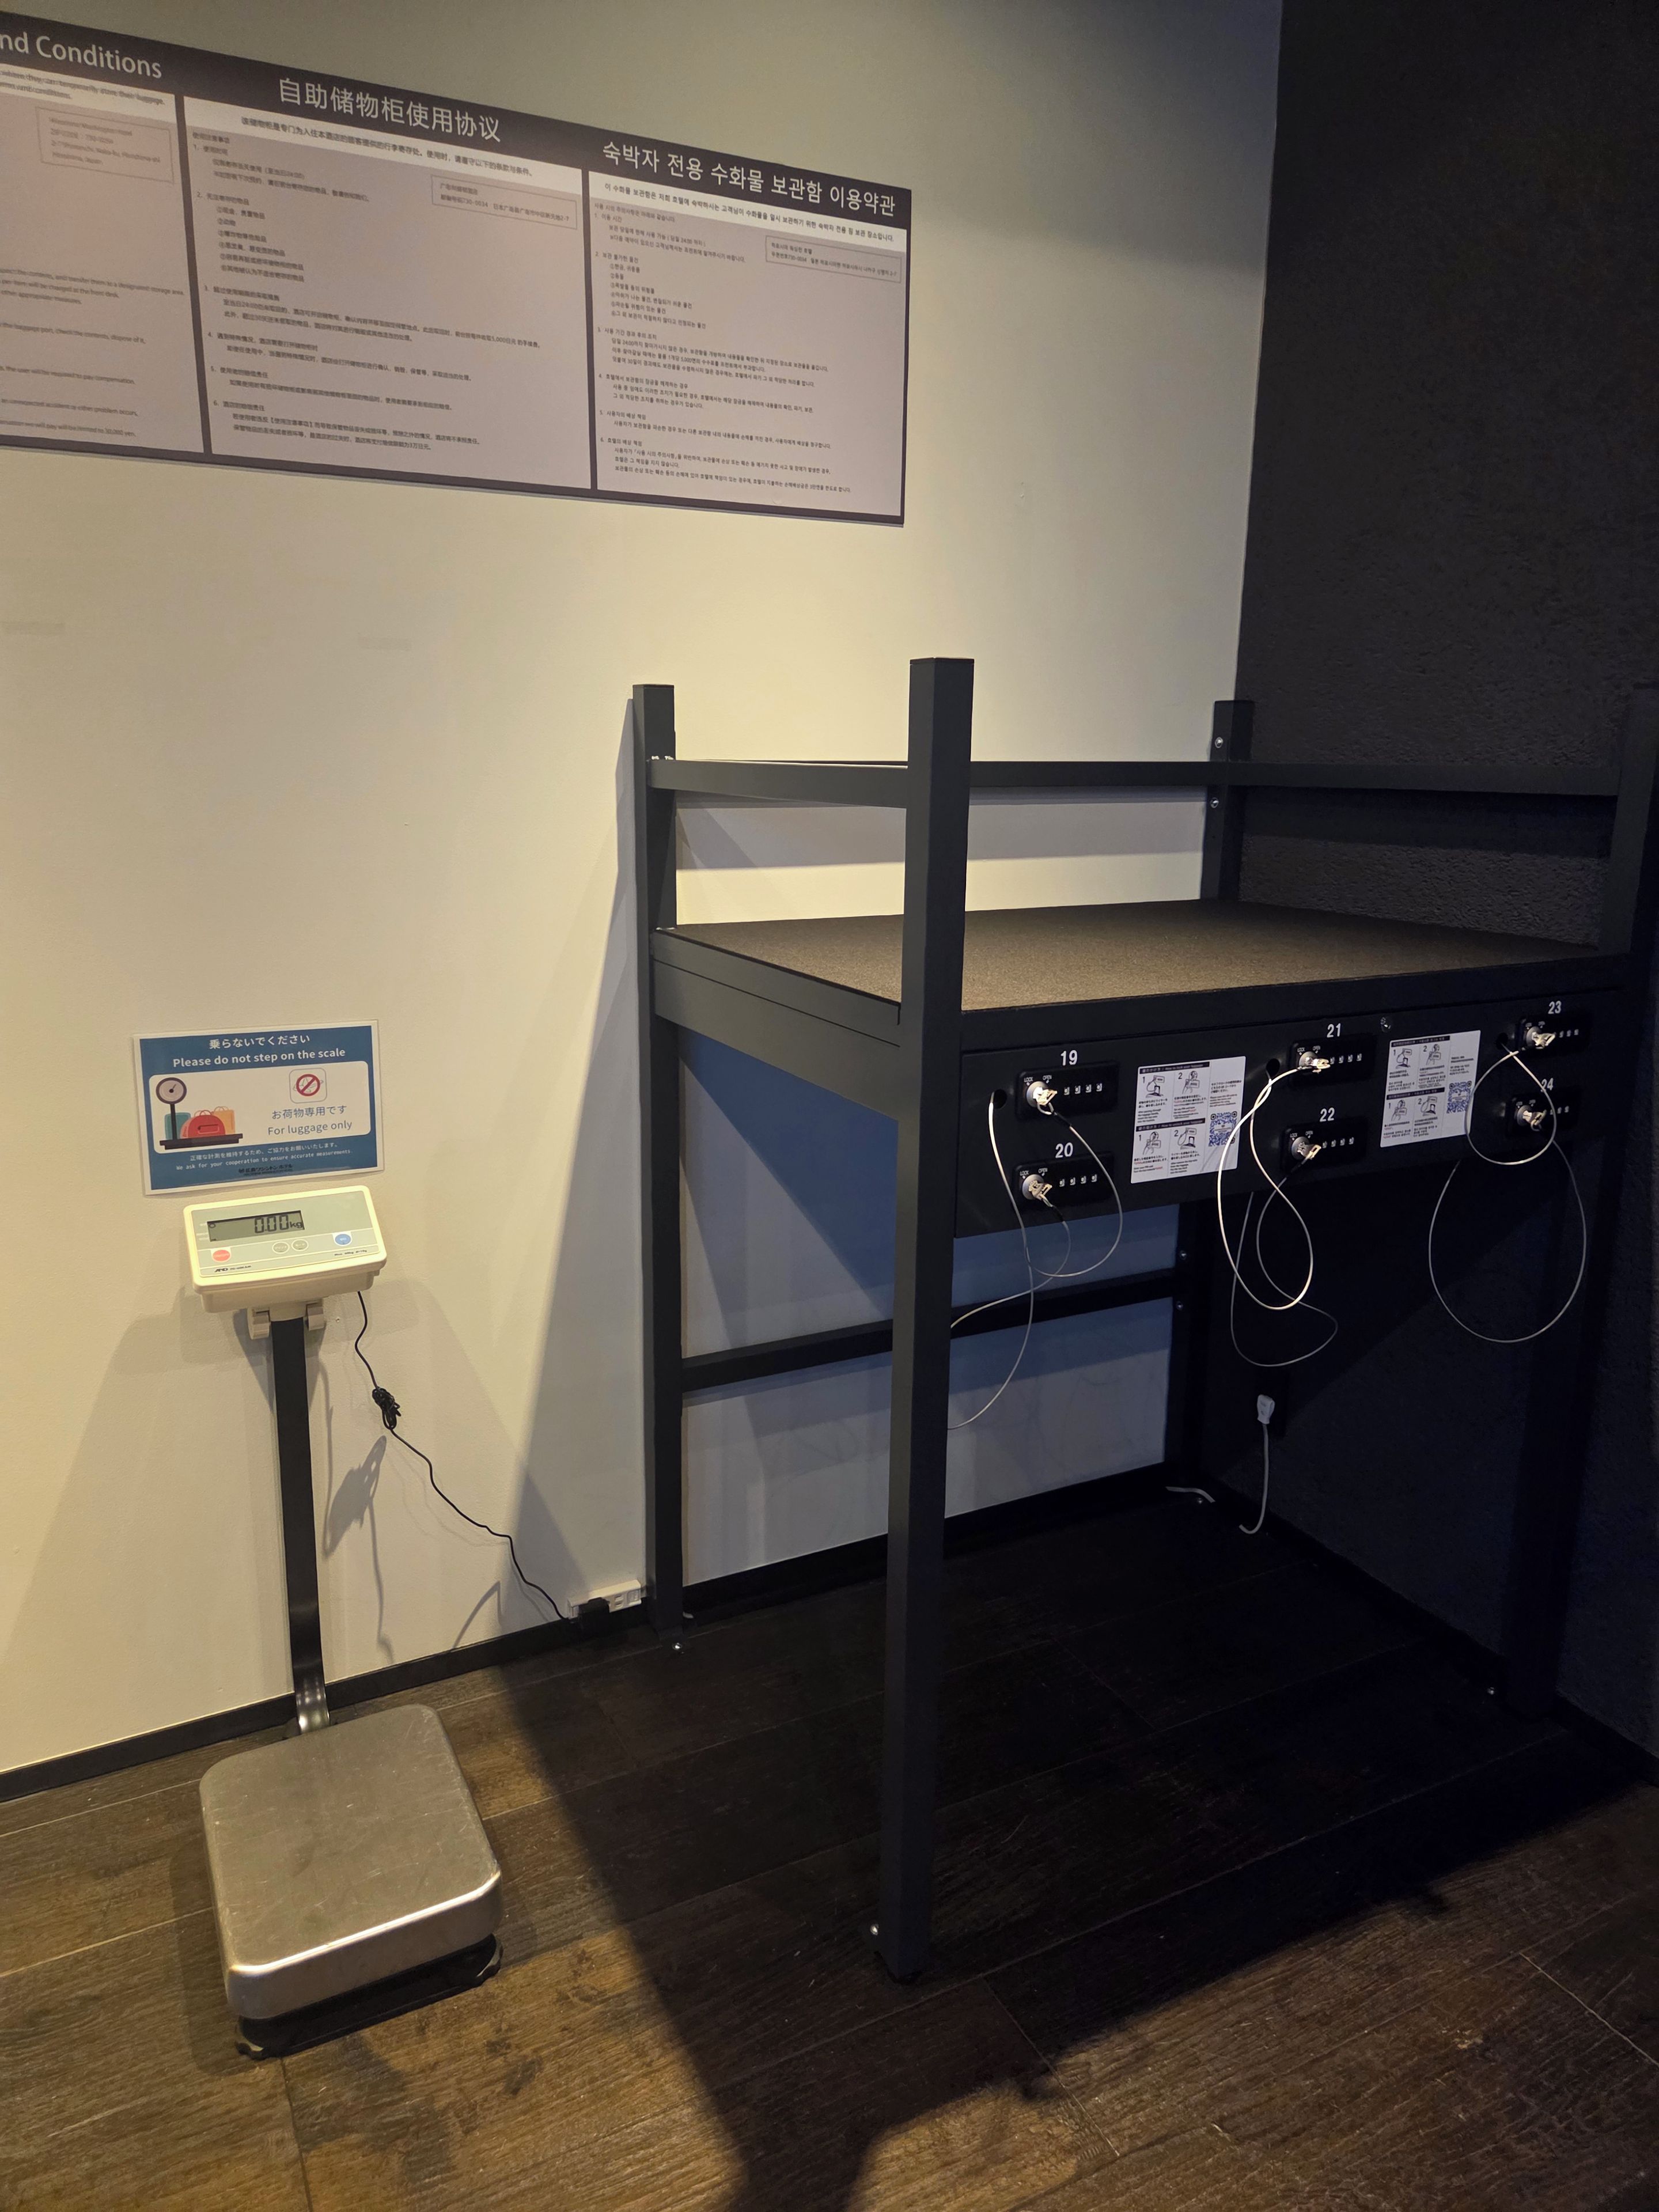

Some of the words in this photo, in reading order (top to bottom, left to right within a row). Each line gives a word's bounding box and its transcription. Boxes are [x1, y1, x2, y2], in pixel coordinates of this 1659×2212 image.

[0, 26, 29, 54] nd
[35, 33, 161, 79] Conditions
[279, 75, 500, 143] 自助储物柜使用协议
[602, 139, 660, 173] 숙박자
[667, 151, 703, 182] 전용
[710, 160, 764, 194] 수화물
[770, 172, 823, 204] 보관함
[829, 183, 896, 218] 이용약관
[604, 182, 611, 191] 이
[612, 184, 631, 195] 수화물
[632, 187, 656, 200] 보관함은
[672, 195, 690, 206] 호텔에
[691, 198, 719, 212] 숙박하시는
[721, 204, 744, 216] 고객님이
[782, 215, 804, 227] 보관하기
[854, 228, 865, 237] 보관
[1548, 1001, 1562, 1014] 23
[1327, 1023, 1341, 1037] 21
[208, 1033, 310, 1050] 乗らないでください
[172, 1055, 211, 1067] Please
[213, 1054, 229, 1065] do
[231, 1054, 251, 1063] not
[253, 1052, 278, 1063] step
[280, 1052, 294, 1060] on
[297, 1048, 316, 1059] the
[317, 1047, 346, 1058] scale
[1060, 1050, 1078, 1066] 19
[271, 1103, 347, 1120] お荷物専用です
[1319, 1107, 1335, 1122] 22
[267, 1125, 285, 1136] For
[287, 1121, 328, 1137] luggage
[330, 1119, 353, 1132] only
[1055, 1142, 1074, 1158] 20
[225, 1157, 259, 1166] cooperation
[290, 1152, 315, 1160] accurate
